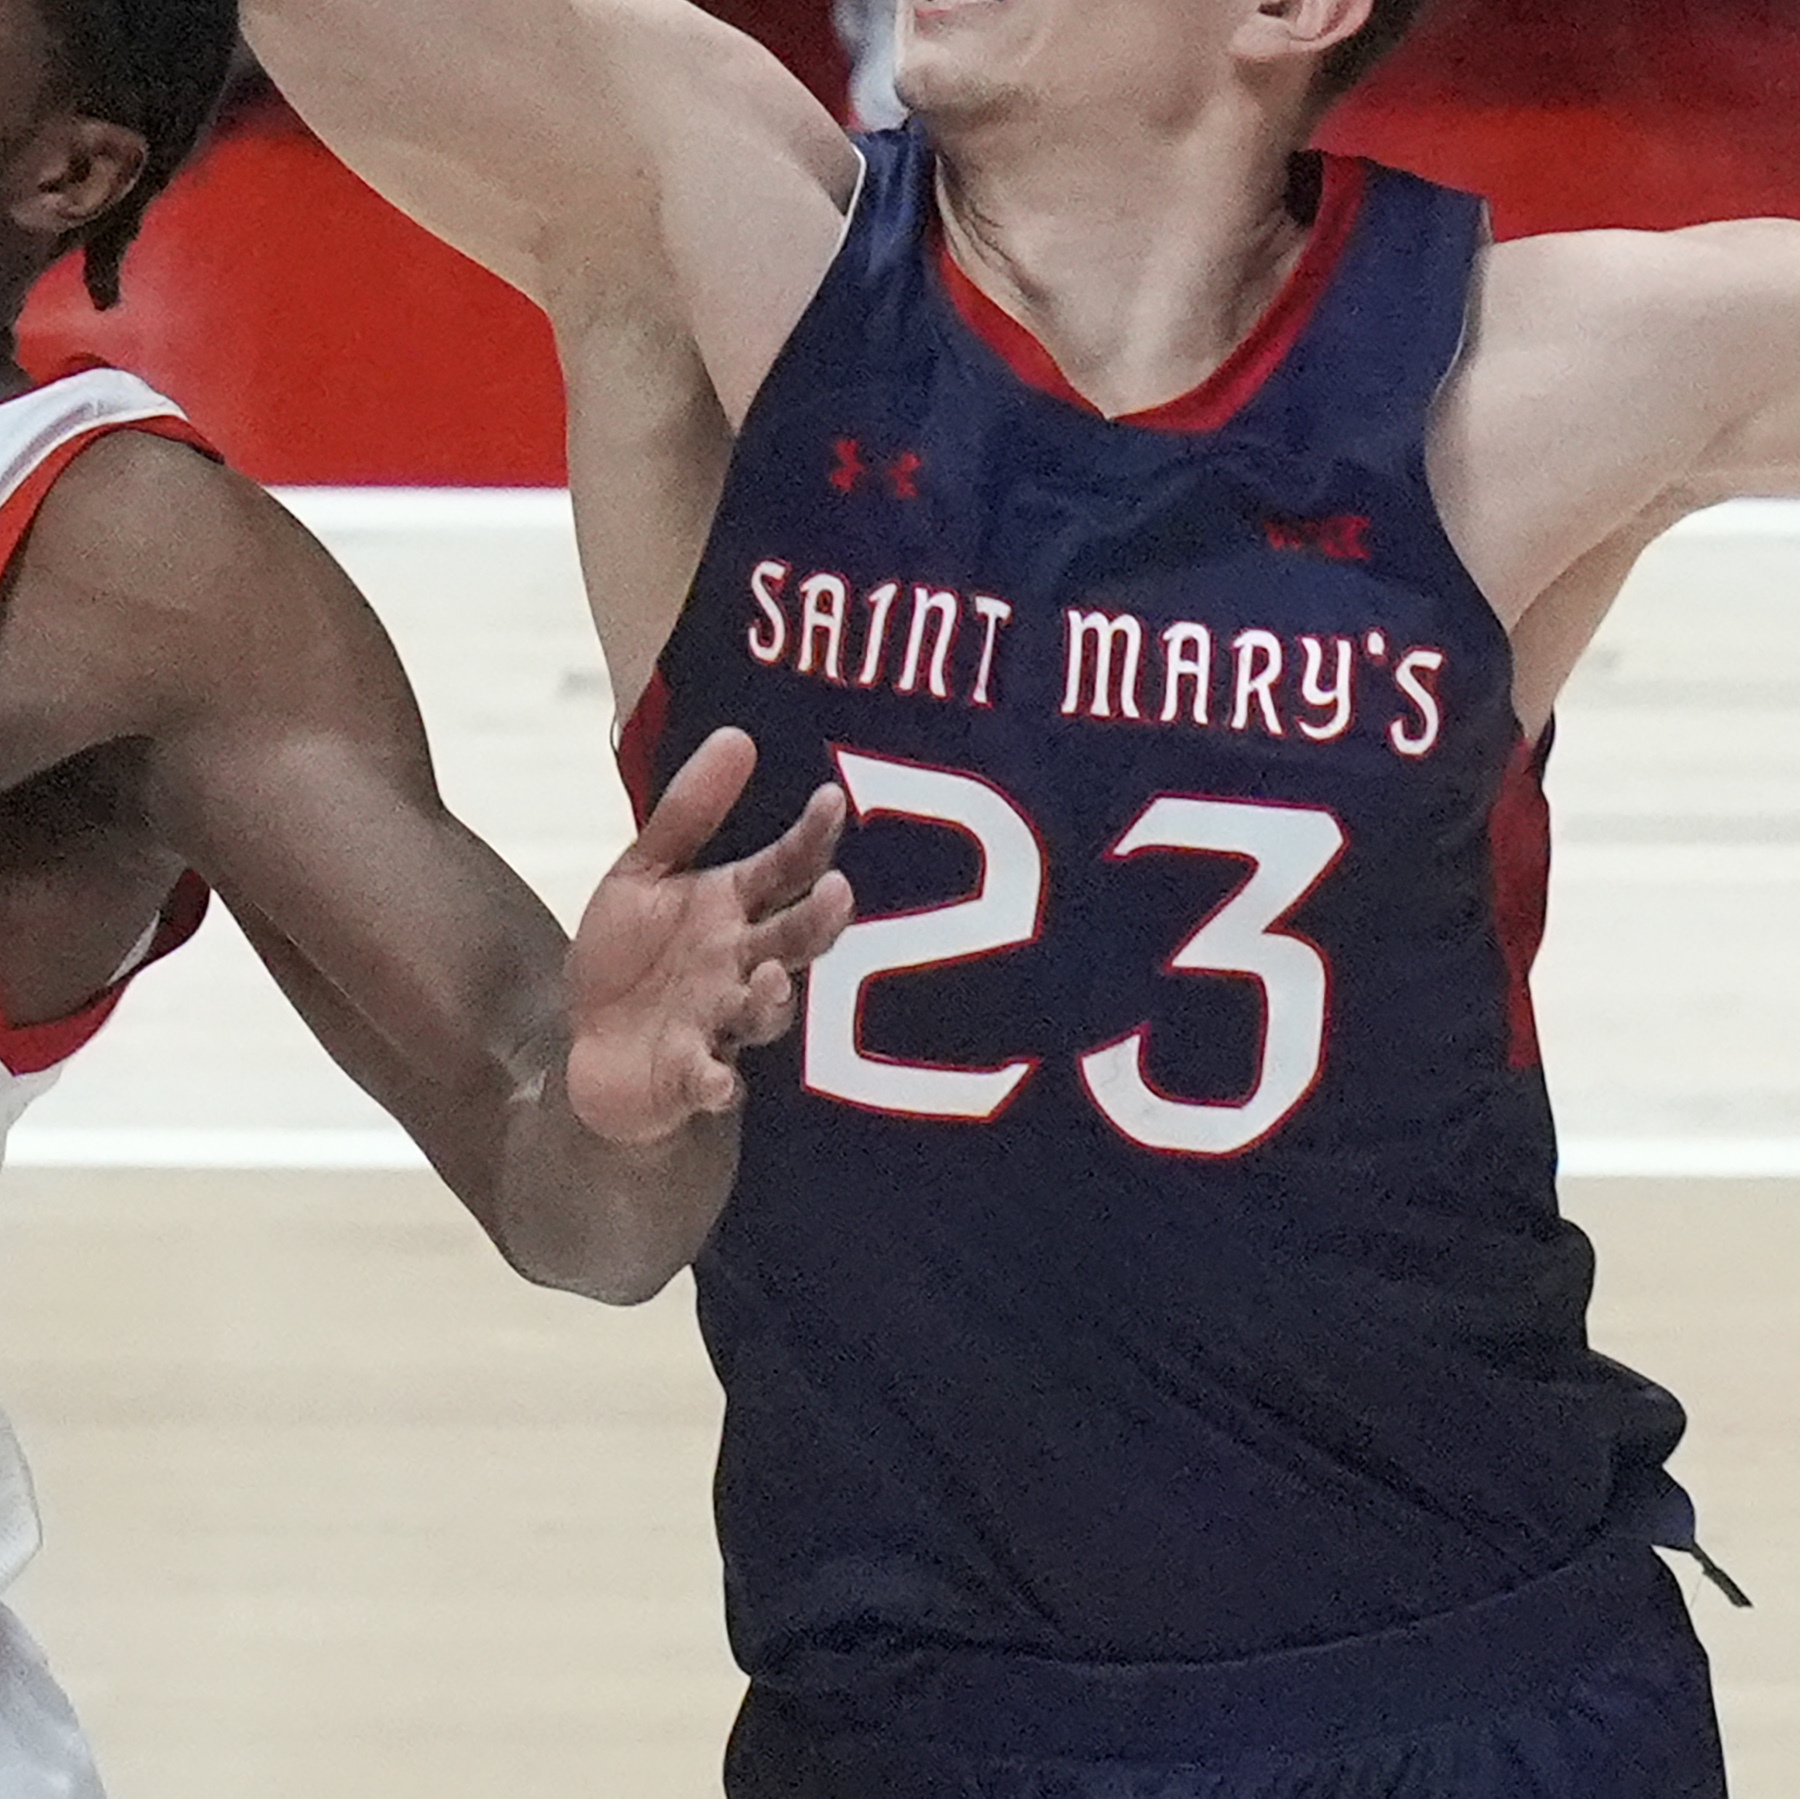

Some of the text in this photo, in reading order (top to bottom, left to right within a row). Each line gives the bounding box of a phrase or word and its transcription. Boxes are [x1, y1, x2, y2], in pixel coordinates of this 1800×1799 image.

[747, 558, 1445, 759] SAINT MARY'S
[803, 742, 1348, 1158] 23
